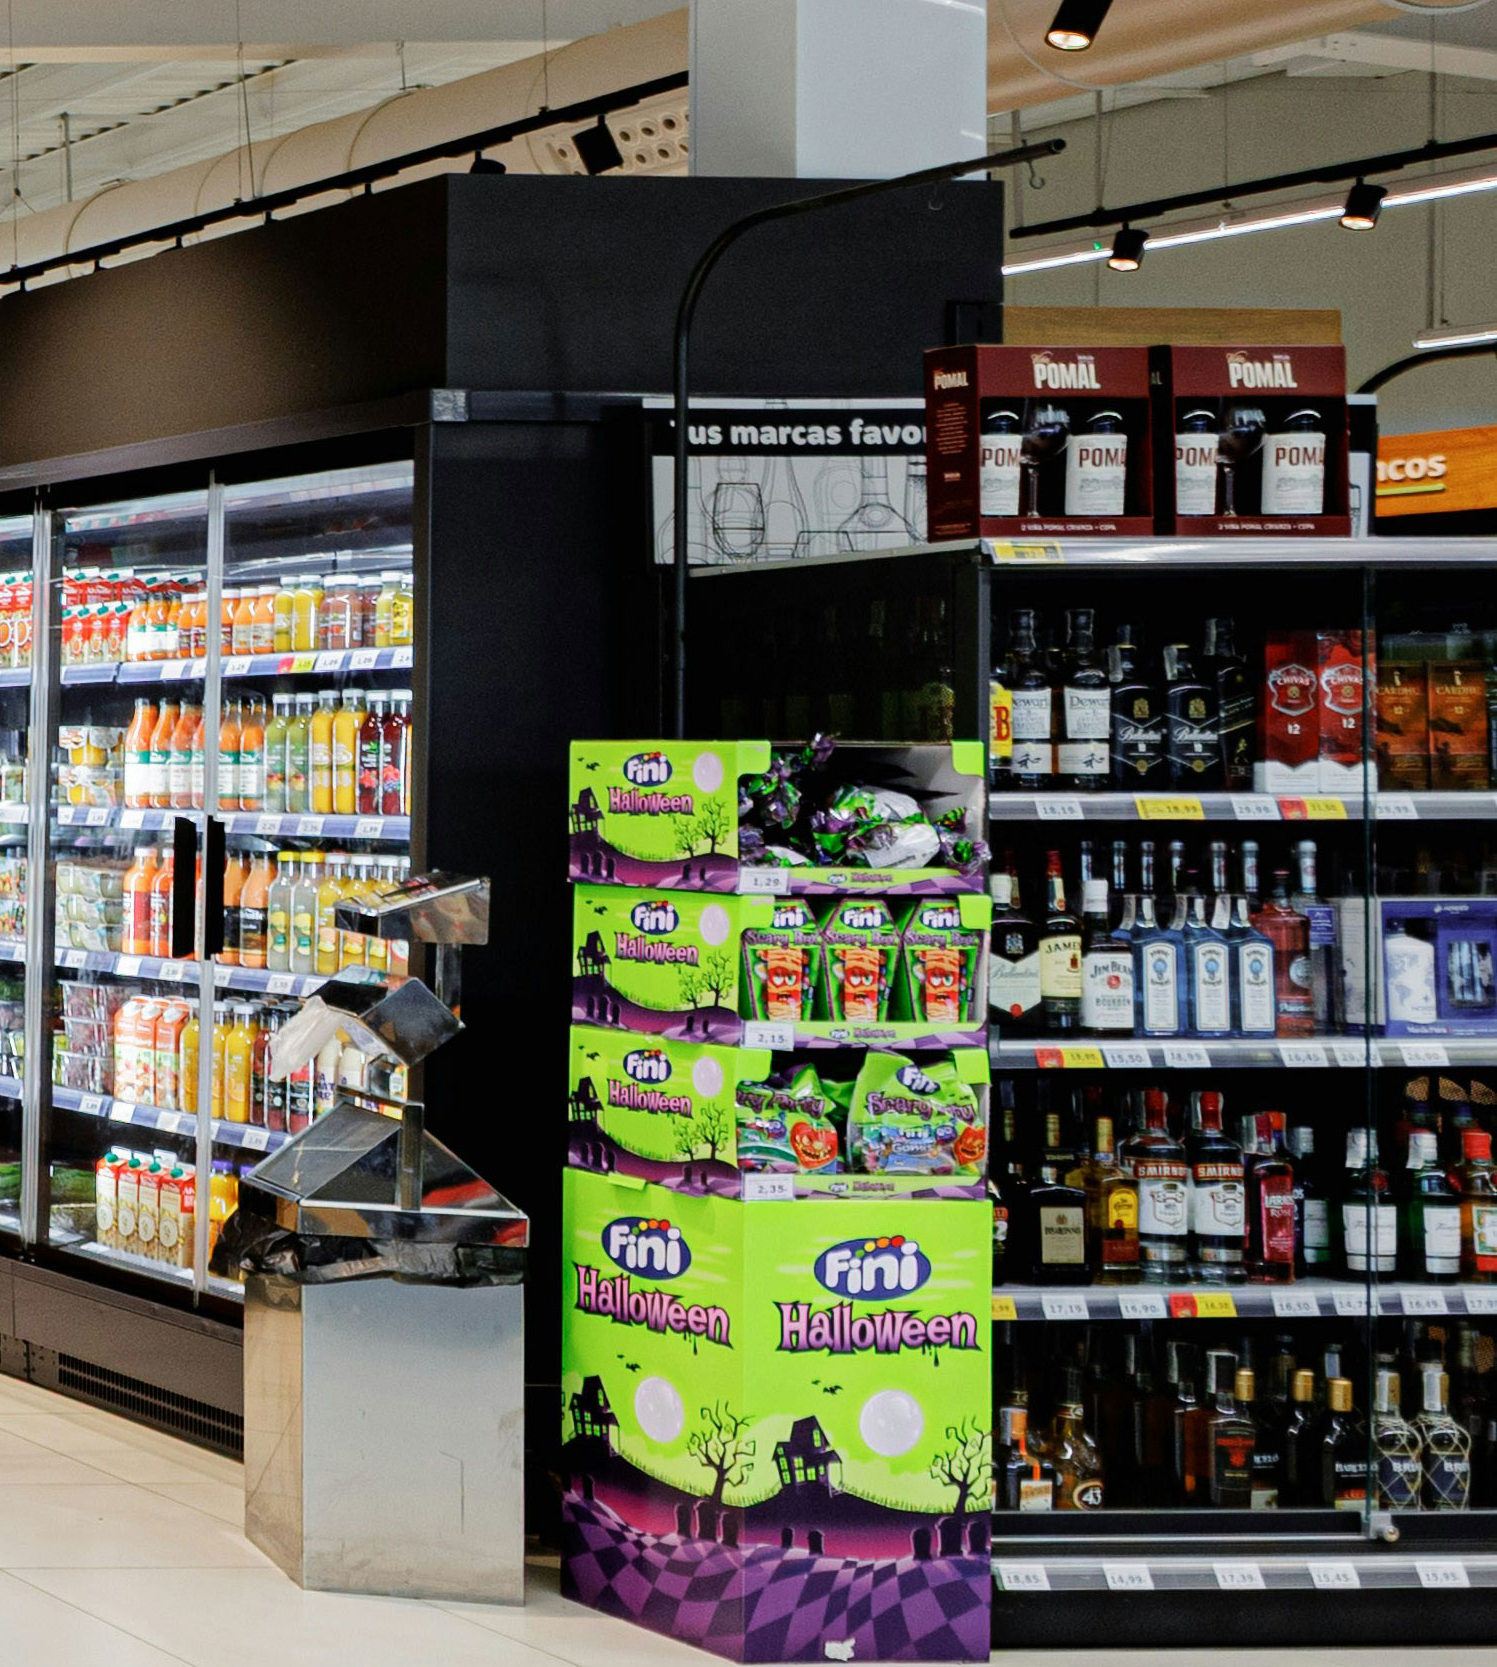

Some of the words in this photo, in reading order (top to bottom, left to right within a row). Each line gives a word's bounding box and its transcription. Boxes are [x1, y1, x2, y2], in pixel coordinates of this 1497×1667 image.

[934, 371, 969, 390] POMAL
[1033, 363, 1102, 389] POMAL
[1228, 362, 1298, 388] POMAL
[670, 419, 722, 445] us
[730, 425, 842, 445] marcas
[849, 418, 926, 445] favo
[1287, 723, 1300, 734] 12
[1343, 718, 1355, 728] 12
[627, 755, 668, 783] Fini
[608, 787, 694, 816] Halloween
[753, 878, 780, 887] 1,29
[634, 905, 675, 933] Fini
[774, 908, 804, 927] ini
[843, 908, 883, 927] Fini
[615, 932, 699, 967] Halloween
[758, 1034, 785, 1044] 2,15
[627, 1053, 668, 1081] Fini
[608, 1079, 693, 1118] Halloween
[758, 1184, 785, 1194] 2,35
[609, 1223, 681, 1275] Fini
[825, 1242, 920, 1295] Fini
[574, 1263, 734, 1350] Halloween
[775, 1300, 982, 1355] Halloween
